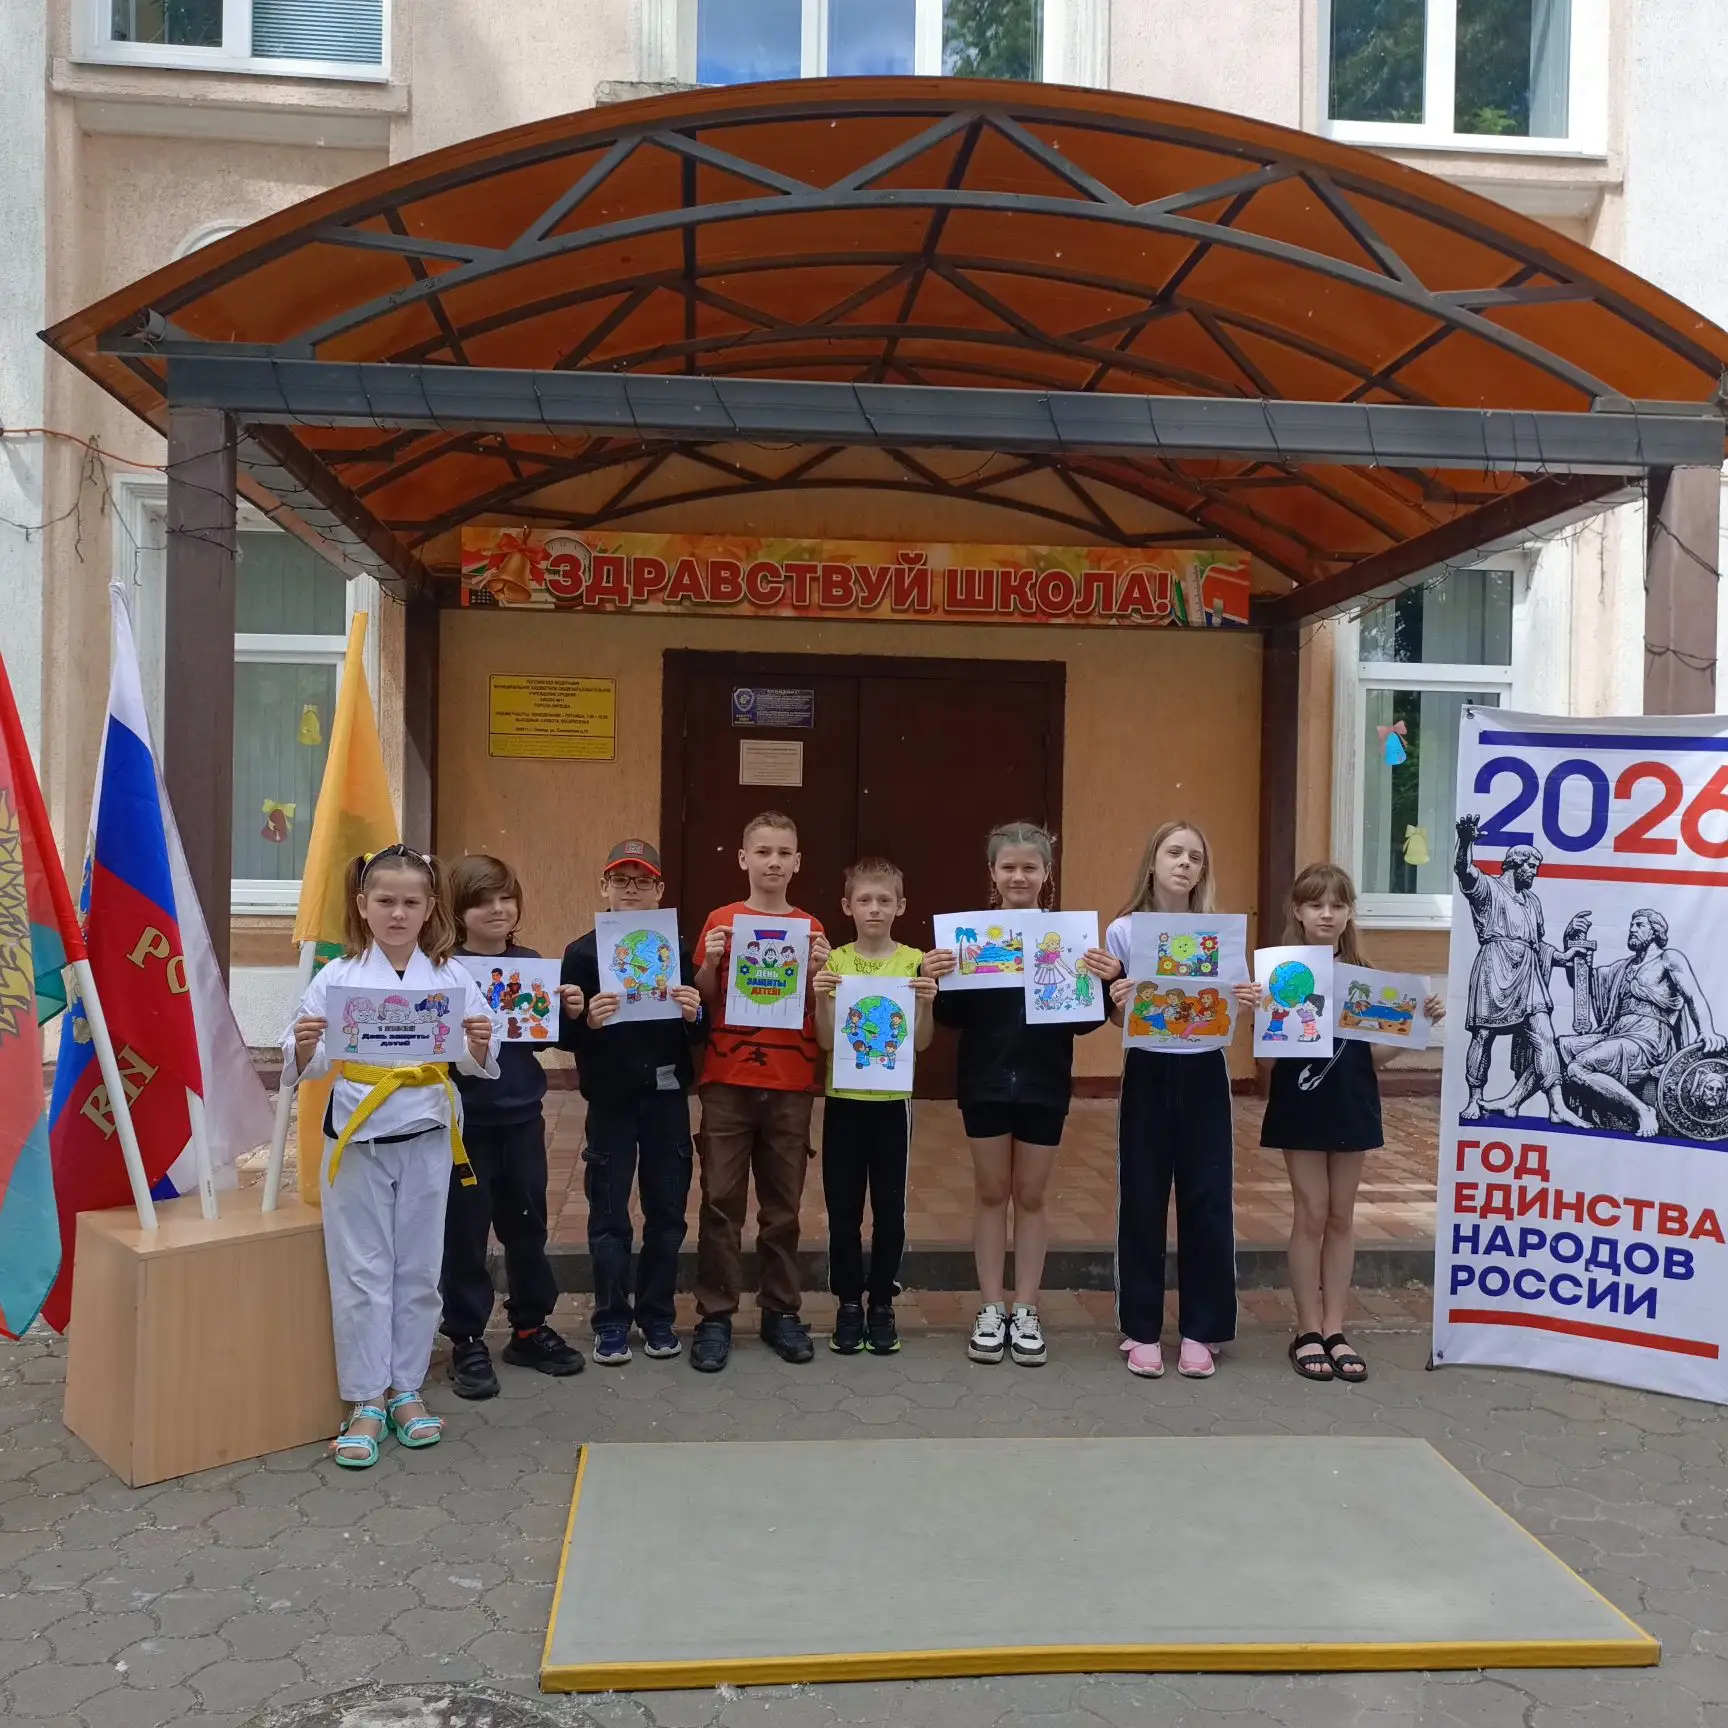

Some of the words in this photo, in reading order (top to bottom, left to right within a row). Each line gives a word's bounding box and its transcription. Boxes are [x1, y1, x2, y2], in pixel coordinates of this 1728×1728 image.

[546, 552, 932, 613] ЗДРАВСТВУЙ
[944, 562, 1172, 617] ШКОЛА!
[1474, 756, 1728, 859] 2026
[747, 978, 787, 988] ЗАЩИТЫ
[756, 970, 779, 978] ДЕНЬ
[1455, 1140, 1550, 1182] ГОД
[1454, 1182, 1726, 1244] ЕДИНСТВА
[1452, 1223, 1695, 1281] НАРОДОВ
[1449, 1264, 1658, 1319] РОССИИ
